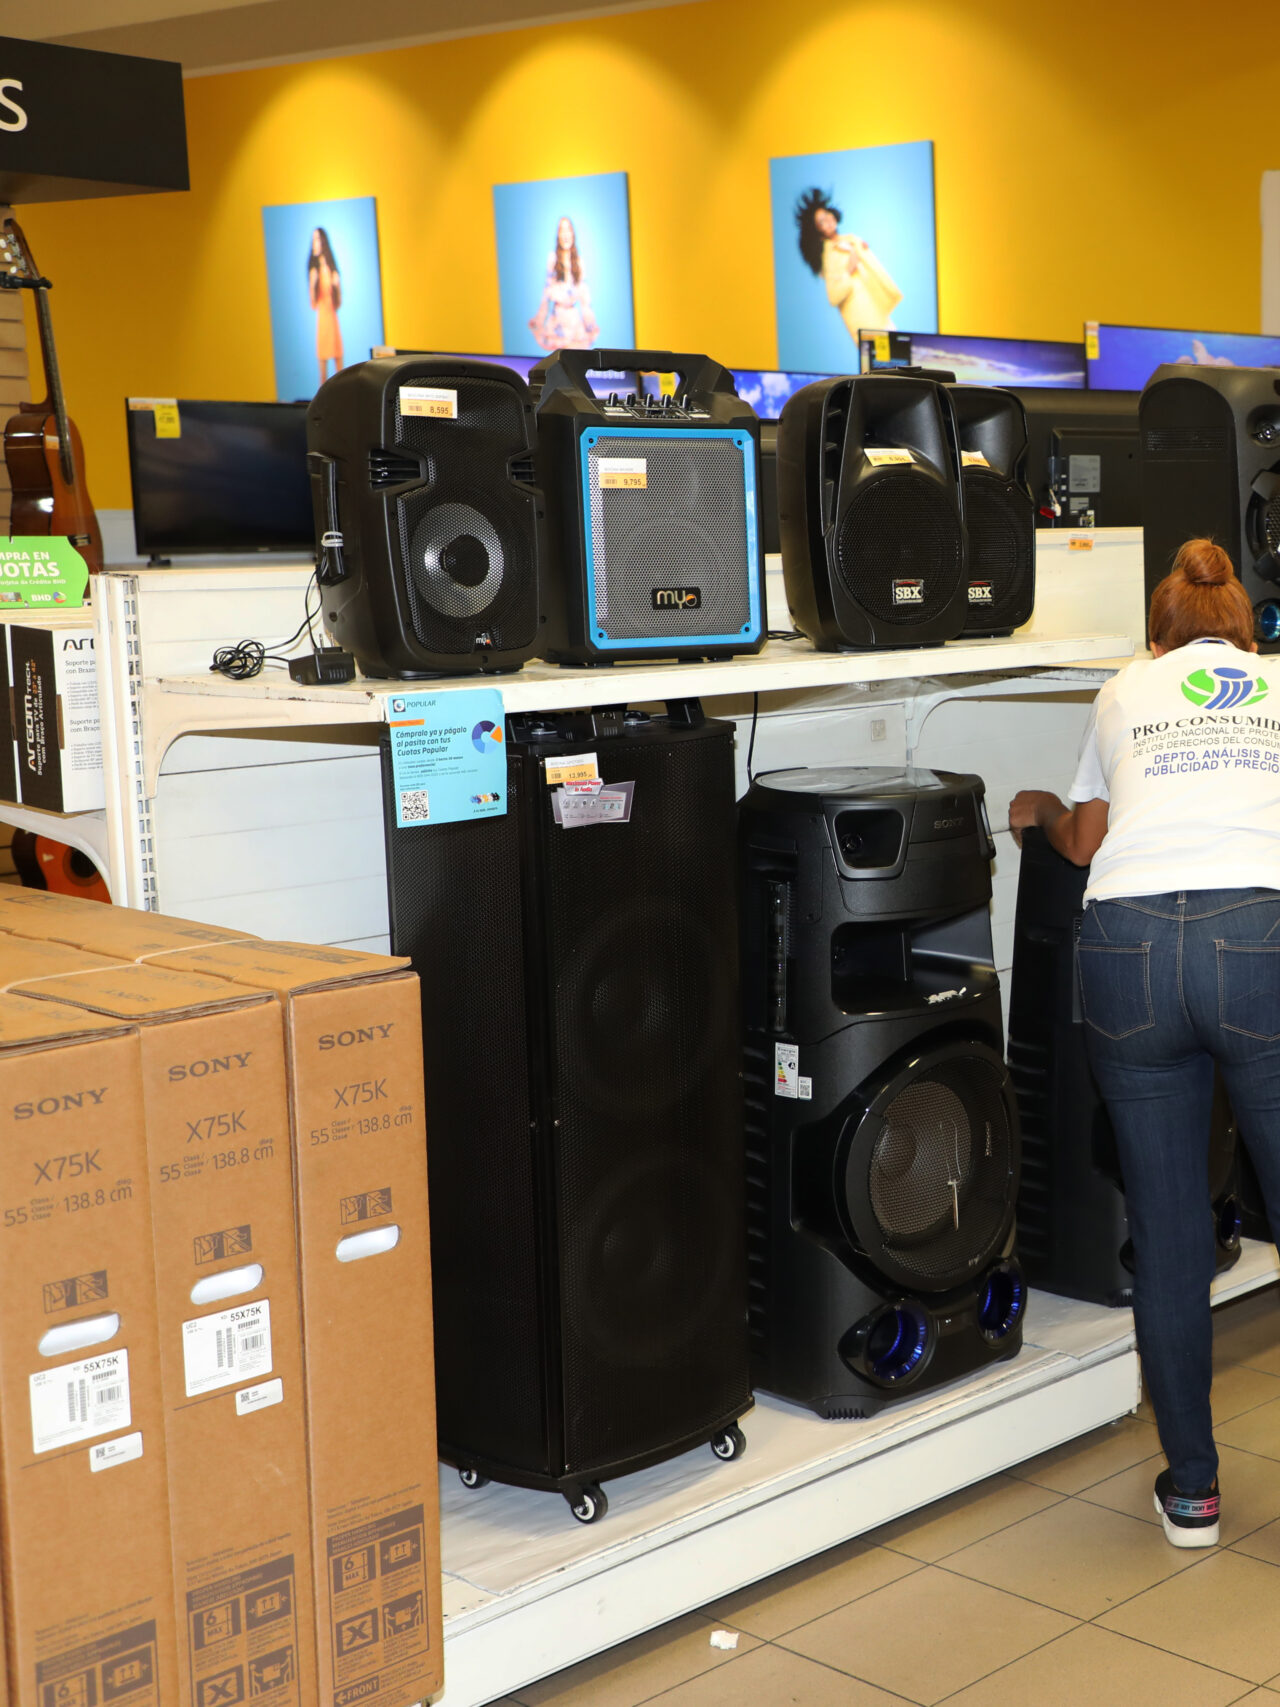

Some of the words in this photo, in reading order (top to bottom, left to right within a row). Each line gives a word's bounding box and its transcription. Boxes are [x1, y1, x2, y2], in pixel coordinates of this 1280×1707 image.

[33, 551, 50, 561] EN
[0, 561, 61, 578] OTAS
[31, 594, 52, 602] BHD
[895, 586, 922, 599] SBX
[967, 586, 993, 599] SBX
[406, 700, 436, 708] POPULAR
[396, 730, 428, 739] Cómpralo
[429, 730, 438, 738] ya
[1132, 721, 1169, 740] PRO
[1133, 729, 1179, 749] INSTITUTO
[1181, 726, 1229, 737] NACIONAL
[1232, 726, 1246, 735] DE
[396, 740, 404, 748] al
[404, 738, 426, 748] pasito
[427, 738, 439, 746] con
[440, 736, 451, 745] tus
[397, 747, 421, 757] Cuotas
[422, 745, 449, 756] Popular
[1132, 748, 1144, 759] DE
[1146, 741, 1164, 753] LOS
[1166, 736, 1220, 749] DERECHOS
[1222, 736, 1241, 745] DEL
[1154, 751, 1199, 764] DEPTO.
[1202, 746, 1261, 760] ANÁLISIS
[1264, 751, 1280, 763] DE
[1144, 759, 1219, 778] PUBLICIDAD
[1222, 759, 1231, 769] Y
[318, 1023, 395, 1051] SONY
[168, 1052, 253, 1082] SONY
[333, 1078, 389, 1109] X75K
[13, 1087, 108, 1121] SONY
[185, 1110, 248, 1144] X75K
[310, 1128, 330, 1146] 55
[357, 1114, 391, 1136] 138.8
[393, 1111, 413, 1127] cm
[33, 1149, 103, 1186] X75K
[160, 1162, 181, 1183] 55
[213, 1147, 250, 1170] 138.8
[253, 1145, 274, 1161] cm
[4, 1206, 28, 1227] 55
[63, 1189, 105, 1213] 138.8
[110, 1186, 133, 1203] cm
[230, 1306, 262, 1322] 55X75K
[83, 1355, 119, 1373] 55X75K
[344, 1556, 354, 1571] 6
[345, 1571, 359, 1581] MAX
[206, 1611, 217, 1626] 6
[207, 1626, 222, 1637] MAX
[57, 1683, 69, 1698] 6
[347, 1680, 378, 1700] FRONT
